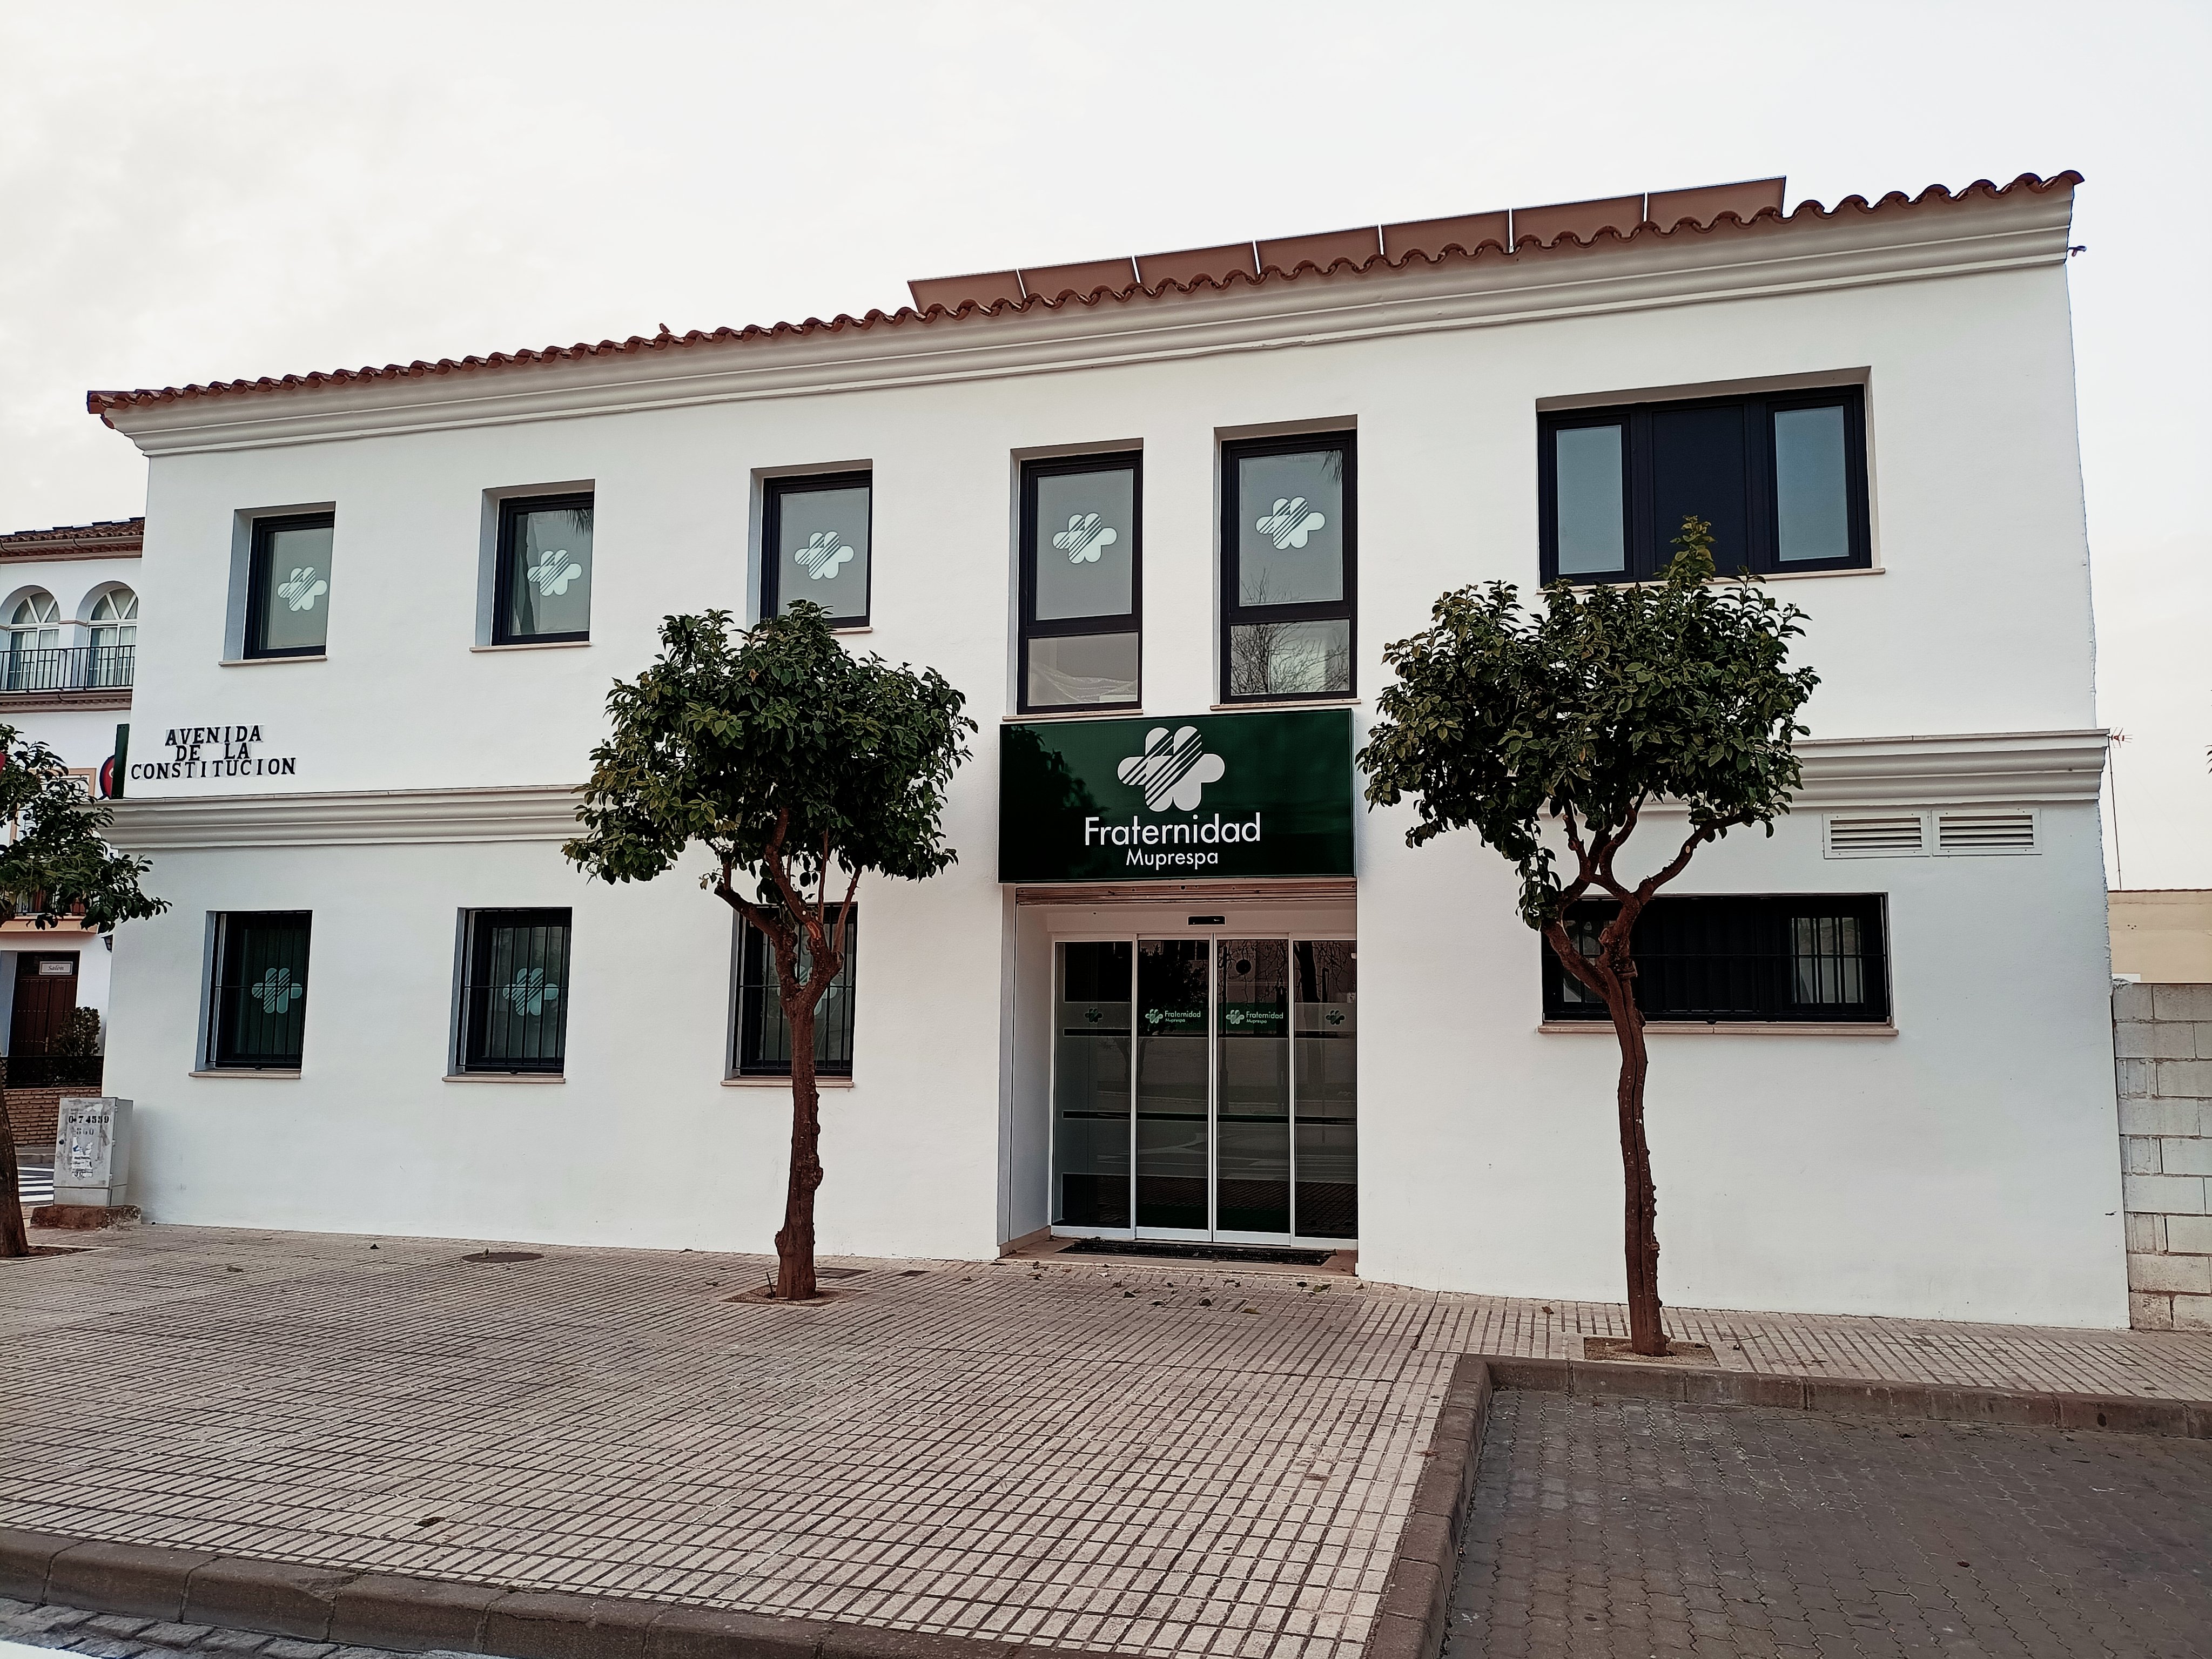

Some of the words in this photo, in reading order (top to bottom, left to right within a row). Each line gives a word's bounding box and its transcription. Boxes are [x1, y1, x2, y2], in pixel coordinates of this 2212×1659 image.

[165, 725, 261, 746] AVENIDA
[175, 744, 200, 761] DE
[224, 743, 250, 759] LA
[131, 757, 296, 780] CONSTITUCION
[1085, 812, 1260, 846] Fraternidad
[1126, 848, 1218, 871] Muprespa
[1246, 1011, 1283, 1019] Fraternidad
